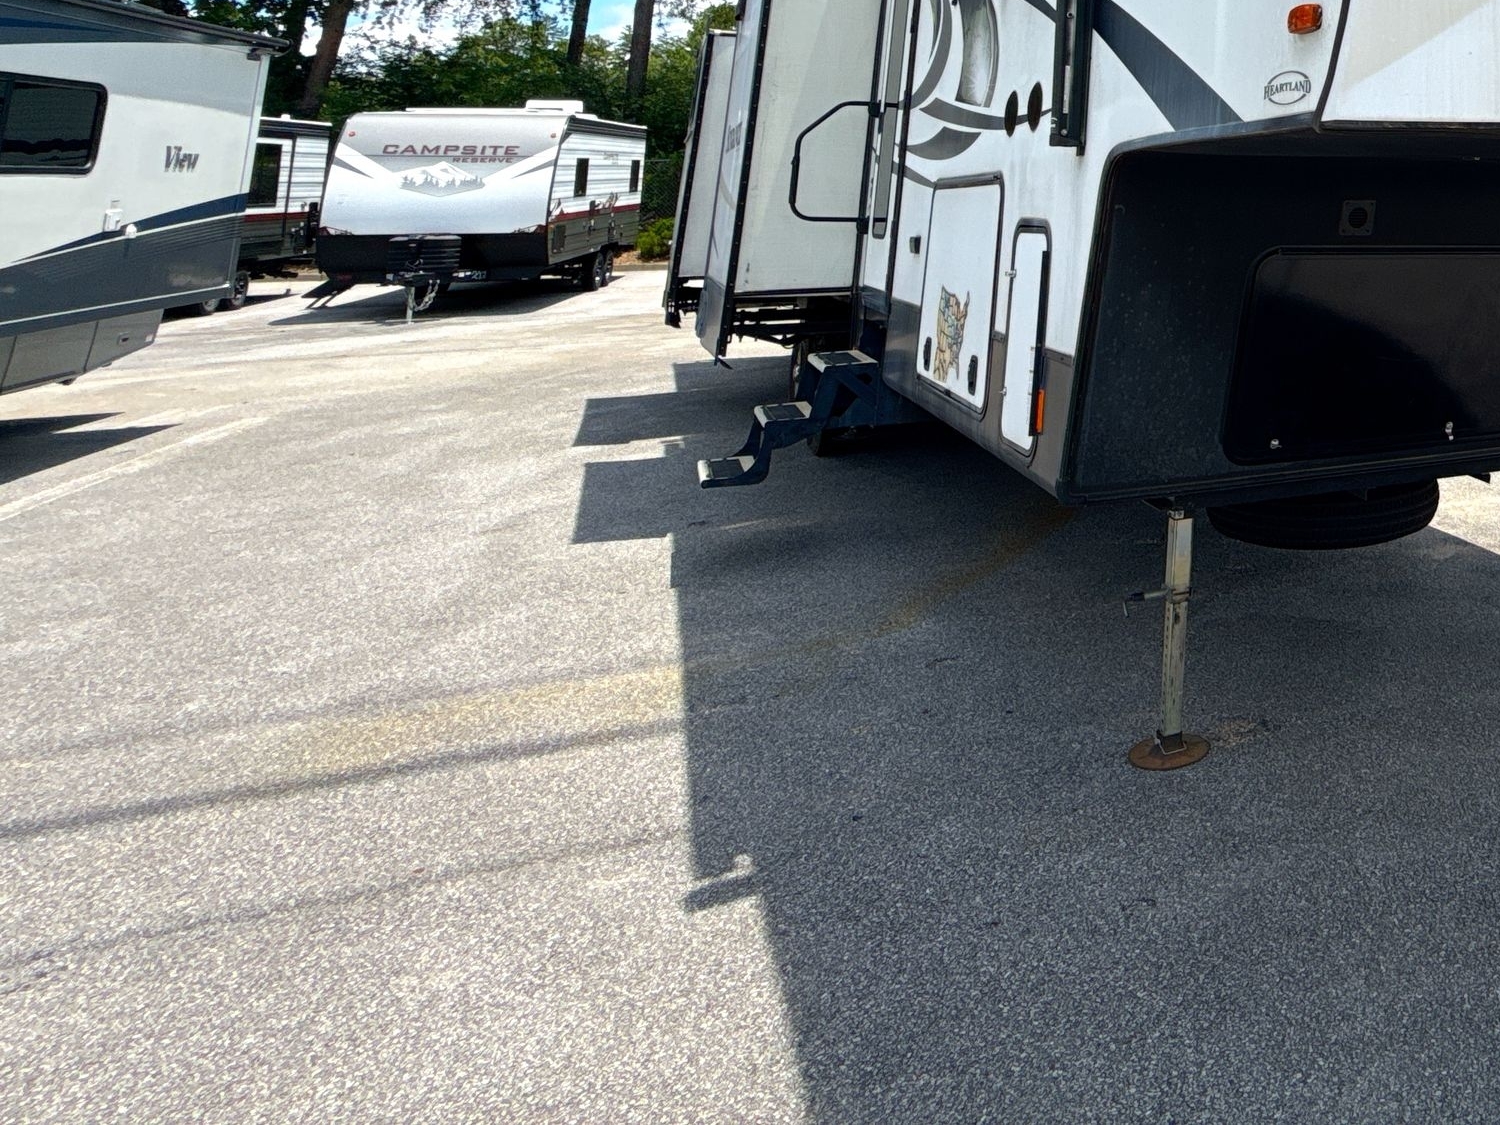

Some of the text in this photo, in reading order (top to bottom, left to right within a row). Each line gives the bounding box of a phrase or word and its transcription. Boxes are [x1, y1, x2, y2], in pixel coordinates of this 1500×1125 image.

[1263, 79, 1311, 100] HEARTLAND
[165, 145, 200, 172] View
[382, 144, 520, 155] CAMPSITE
